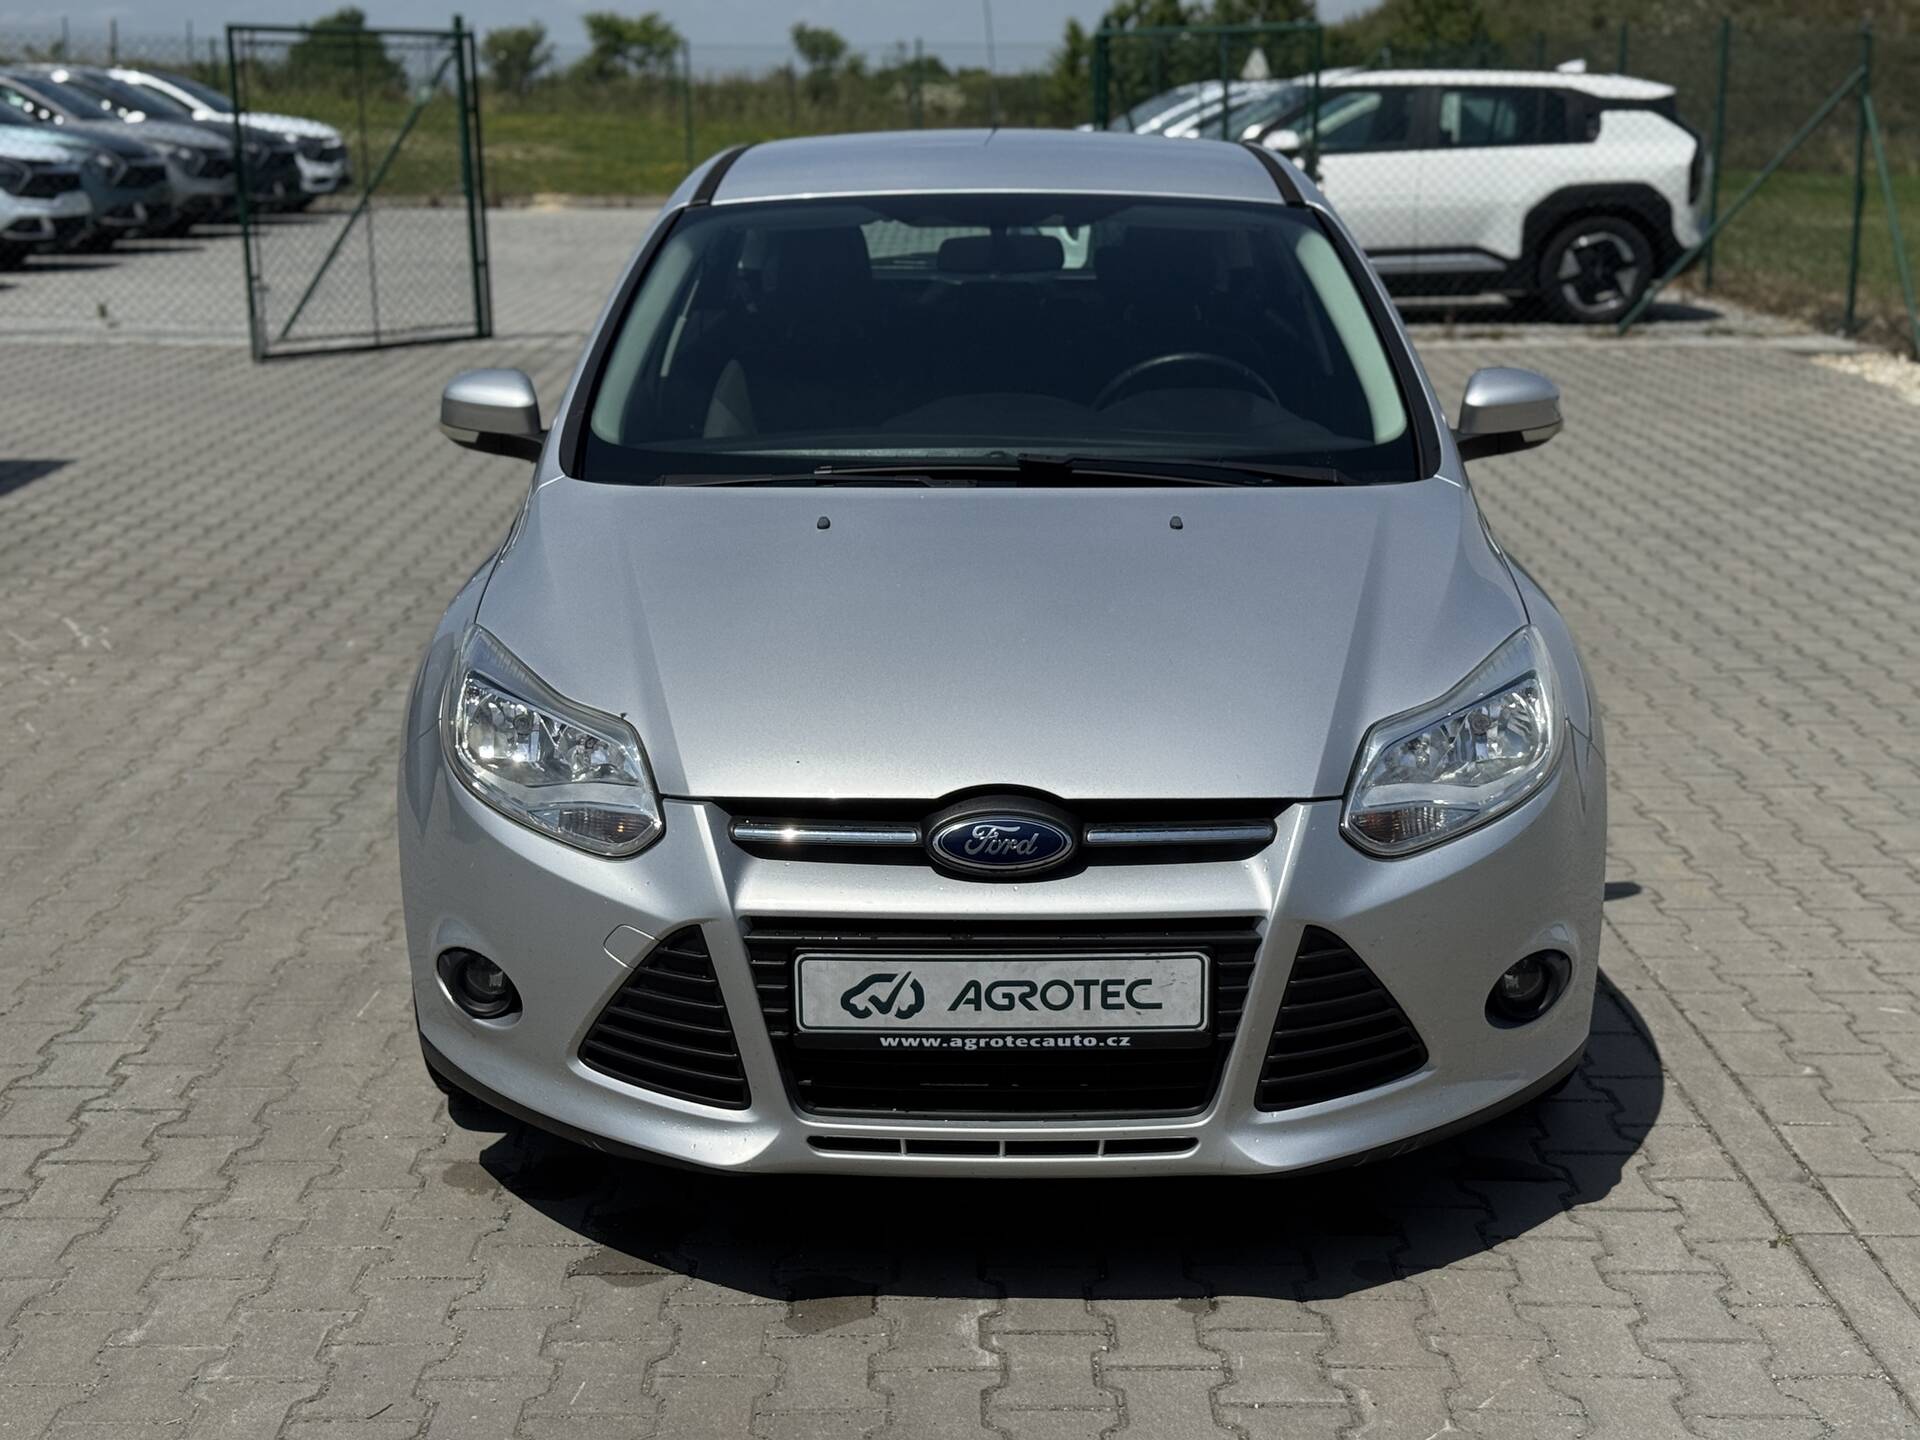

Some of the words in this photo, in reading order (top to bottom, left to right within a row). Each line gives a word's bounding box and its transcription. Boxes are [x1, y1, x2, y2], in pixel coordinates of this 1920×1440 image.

[964, 824, 1040, 856] Ford
[947, 978, 1163, 1012] AGROTEC
[879, 1034, 1131, 1051] www.agrotecauto.cz
